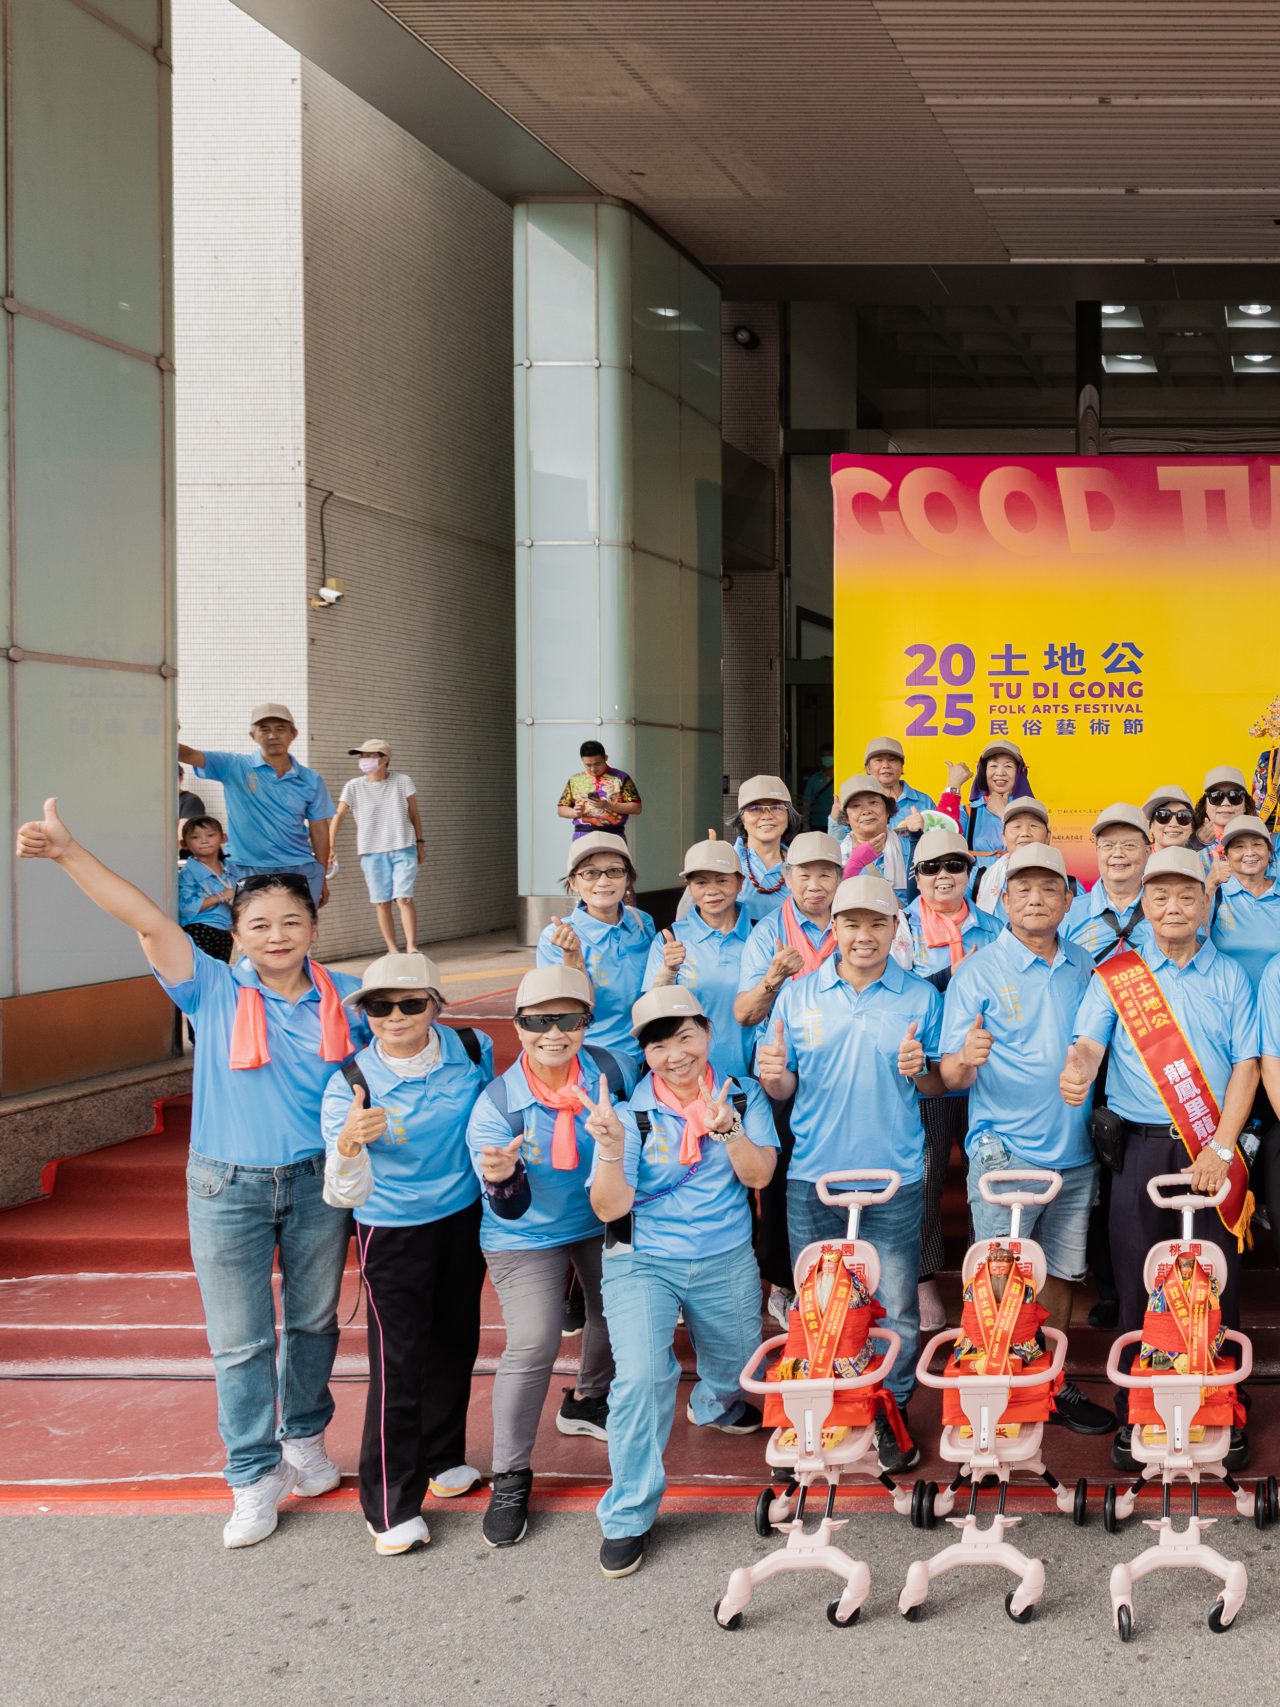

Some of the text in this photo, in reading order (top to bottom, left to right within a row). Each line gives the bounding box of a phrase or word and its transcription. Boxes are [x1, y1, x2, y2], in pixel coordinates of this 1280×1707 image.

[831, 466, 1118, 556] GOOD
[904, 643, 975, 686] 20
[988, 642, 1144, 676] 土地公
[989, 681, 1143, 699] TU DI GONG
[904, 694, 975, 736] 25
[989, 703, 1143, 714] FOLK ARTS FESTIVAL
[990, 718, 1143, 736] 民俗藝術節
[1110, 965, 1144, 986] 2025
[1136, 982, 1170, 1029] 土地公
[1169, 1243, 1202, 1257] 桃園
